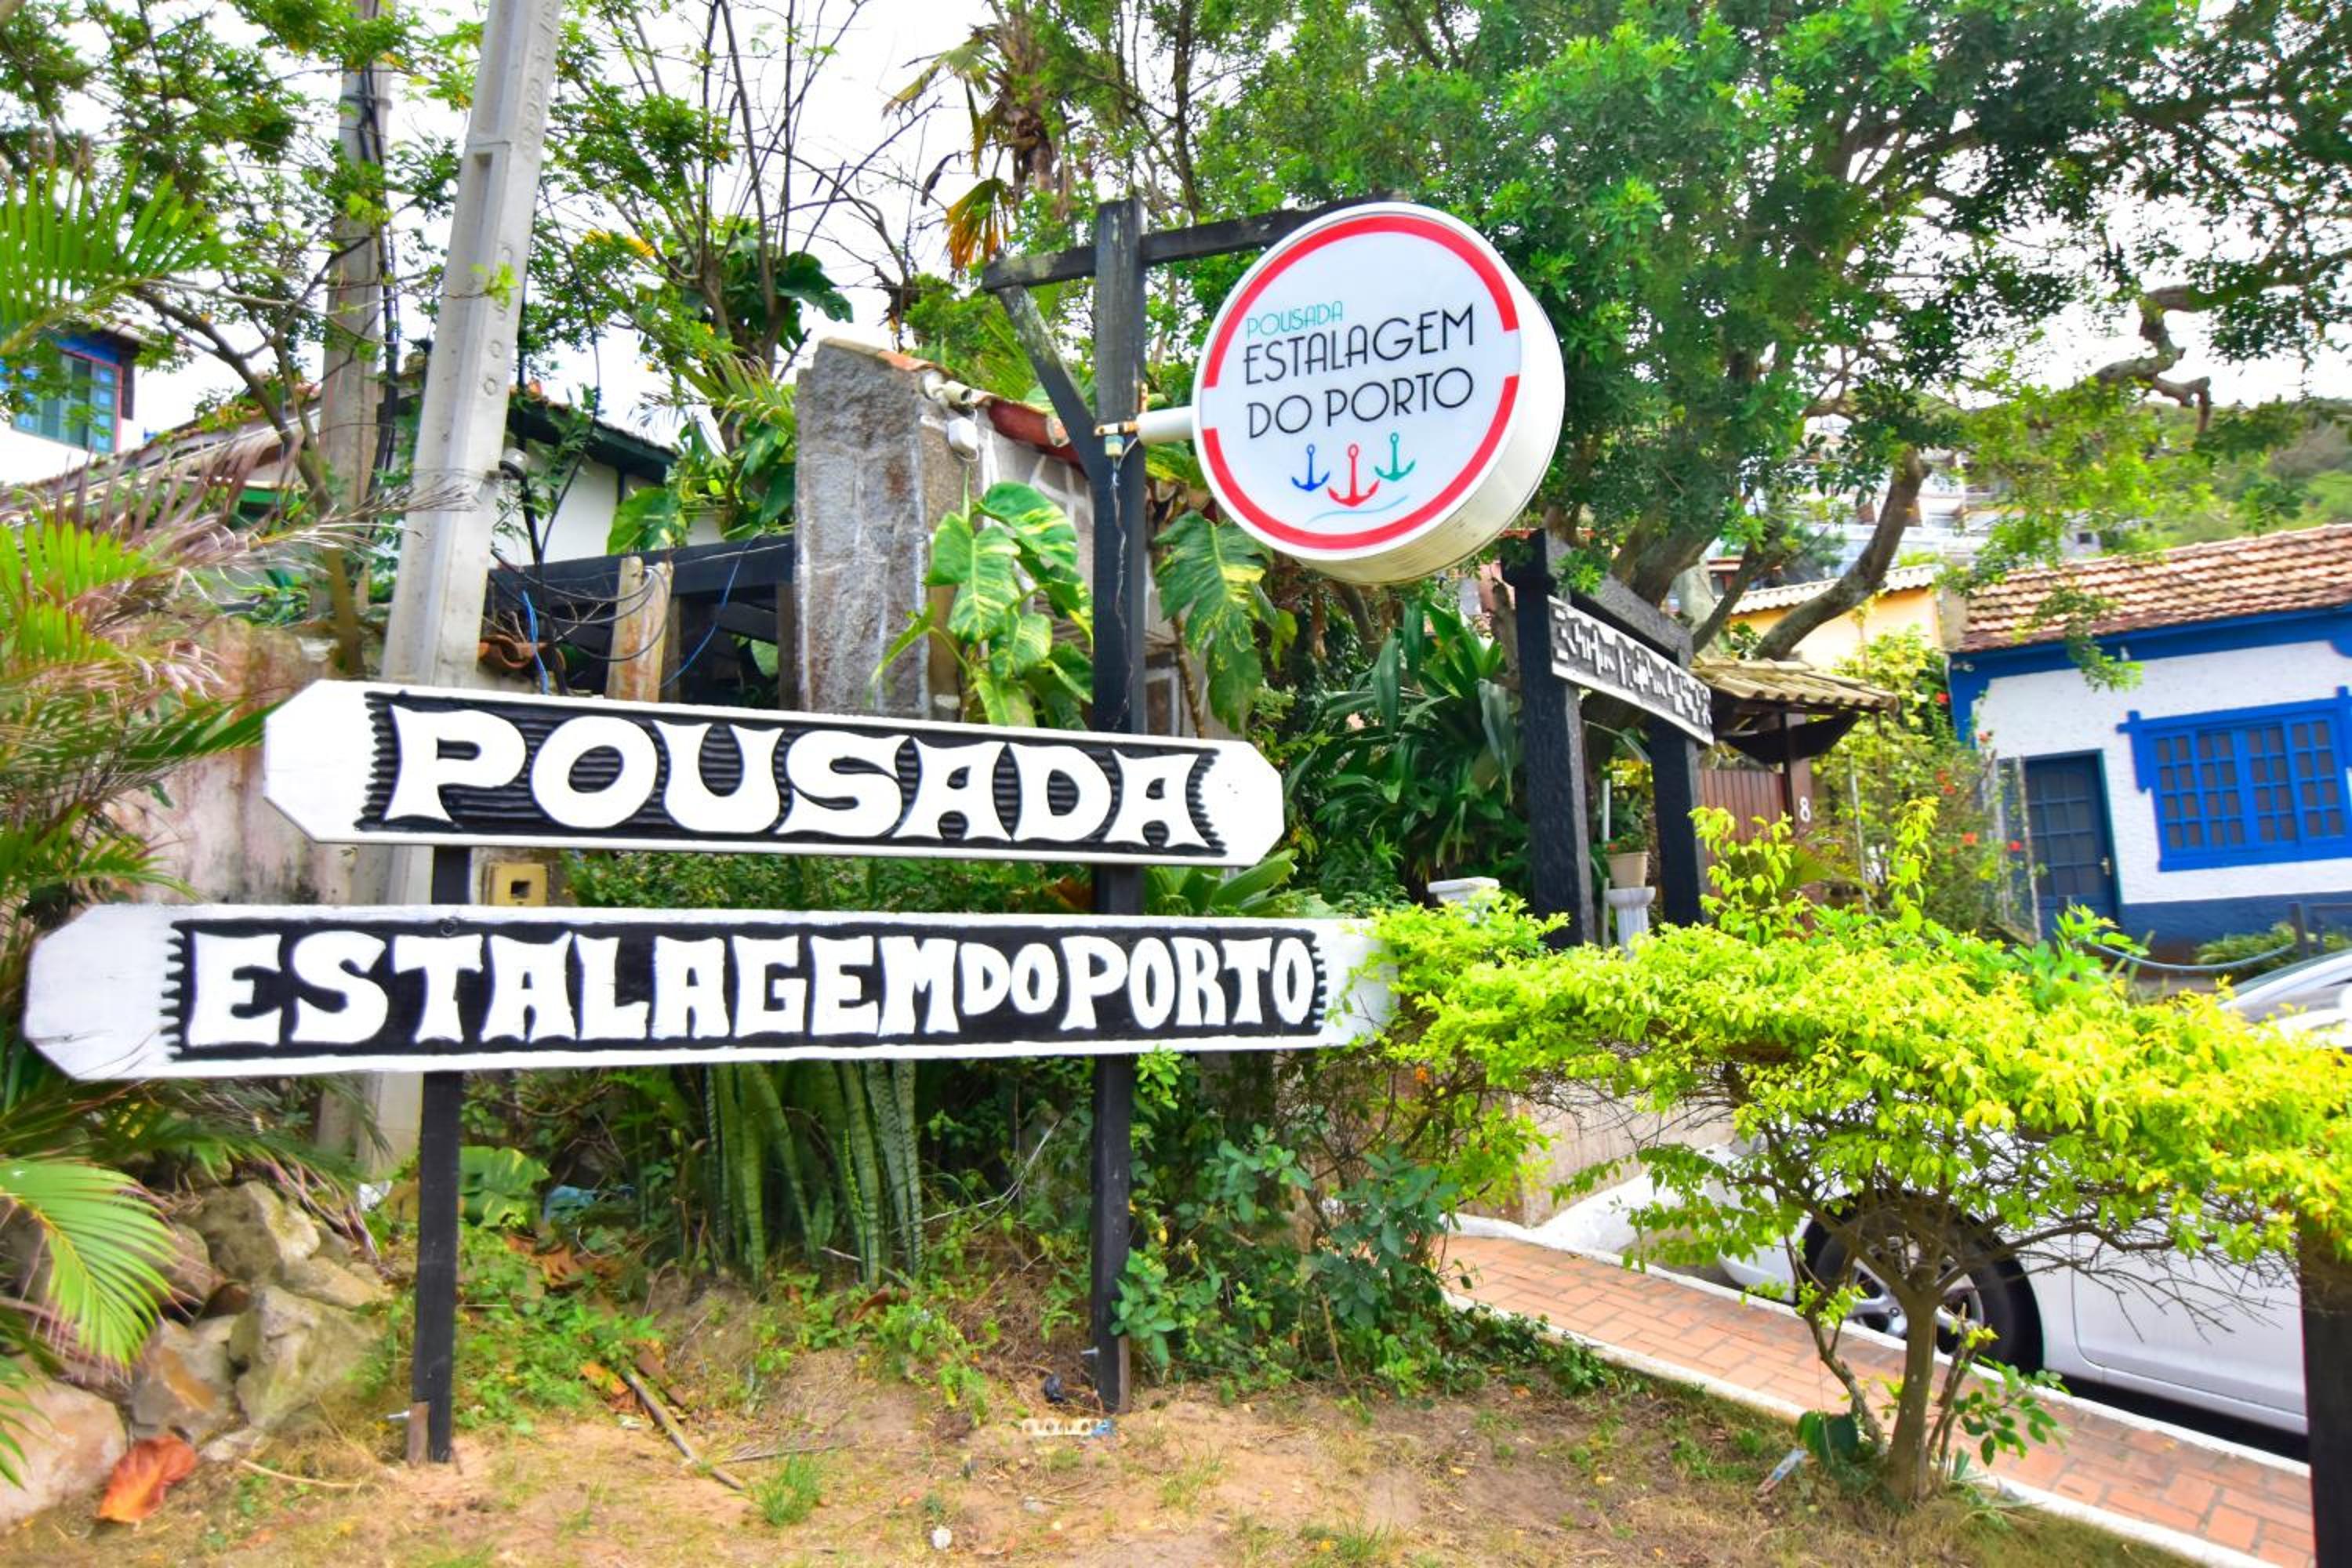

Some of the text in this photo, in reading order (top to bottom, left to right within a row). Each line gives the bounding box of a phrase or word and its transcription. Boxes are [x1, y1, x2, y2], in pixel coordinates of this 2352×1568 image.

[1243, 302, 1475, 386] ESTALAGEM
[1247, 300, 1343, 339] POUSADA
[1247, 367, 1474, 439] DO PORTO
[383, 704, 1210, 849] POUSADA
[1799, 796, 1811, 823] 8
[186, 930, 1316, 1047] ESTALAGEM DO PORTO
